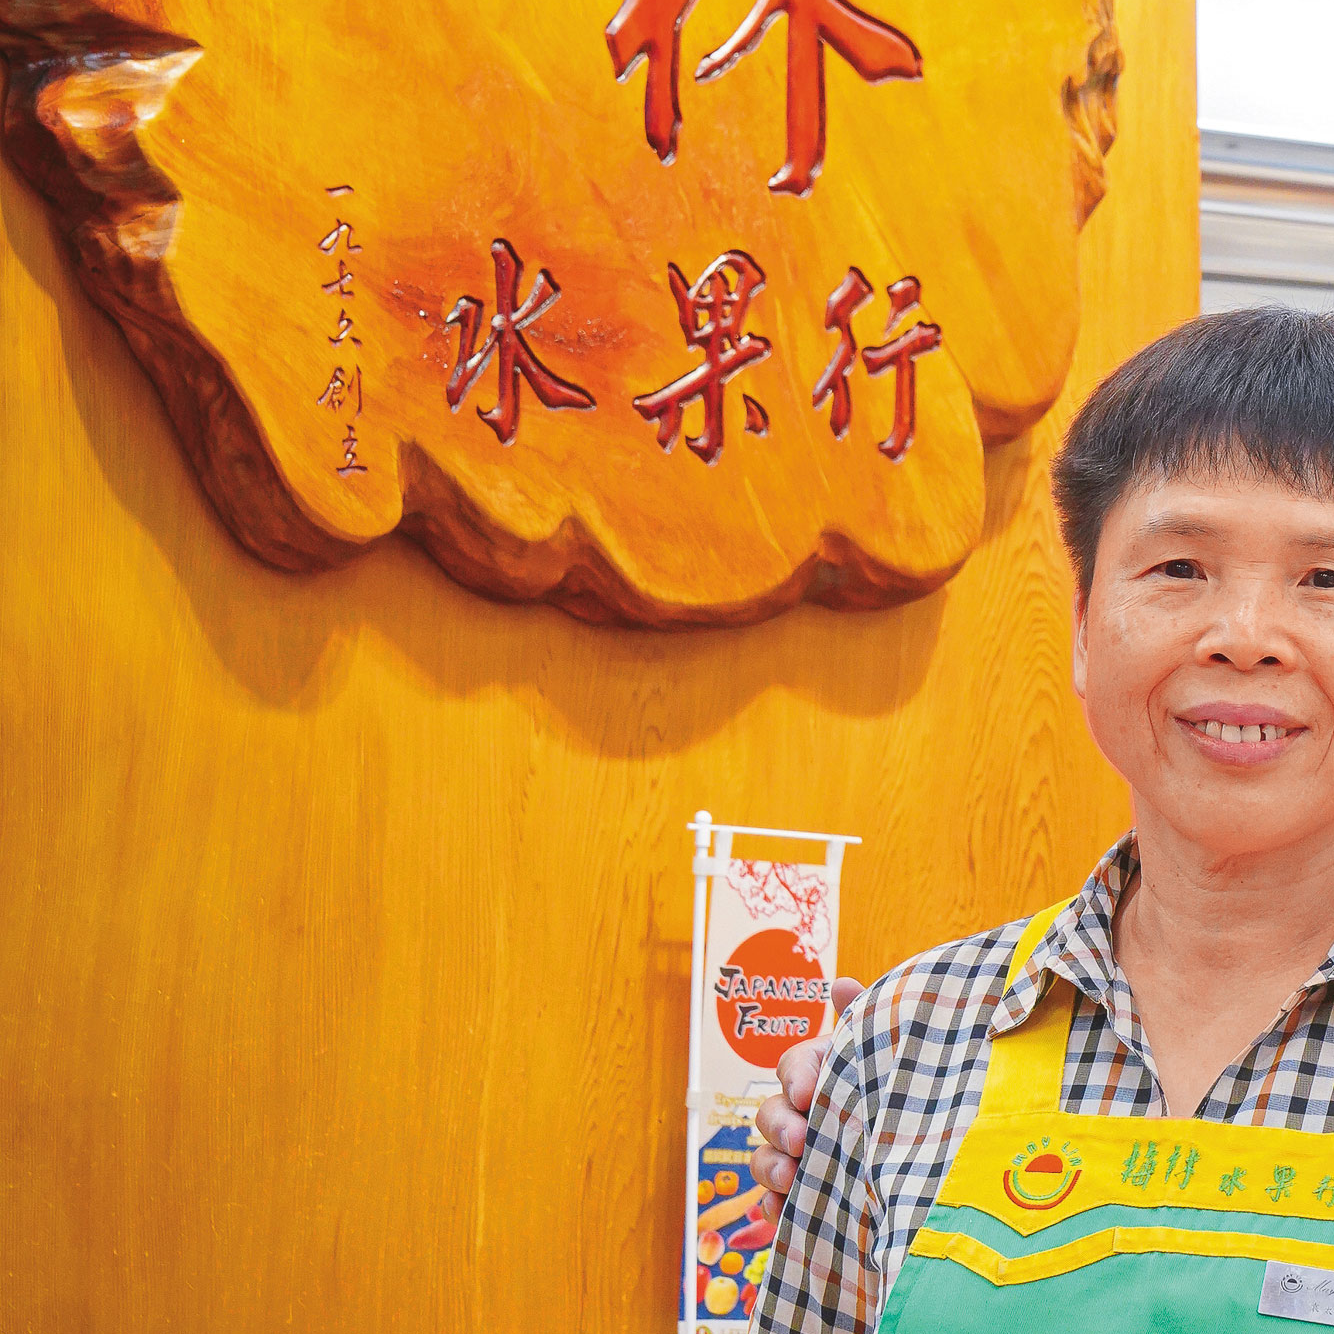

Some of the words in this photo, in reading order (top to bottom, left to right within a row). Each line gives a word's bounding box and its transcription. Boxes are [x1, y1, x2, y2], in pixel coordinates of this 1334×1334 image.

[446, 237, 942, 467] 水果行
[714, 966, 831, 1000] JAPANESE
[737, 1004, 809, 1036] FRUITS
